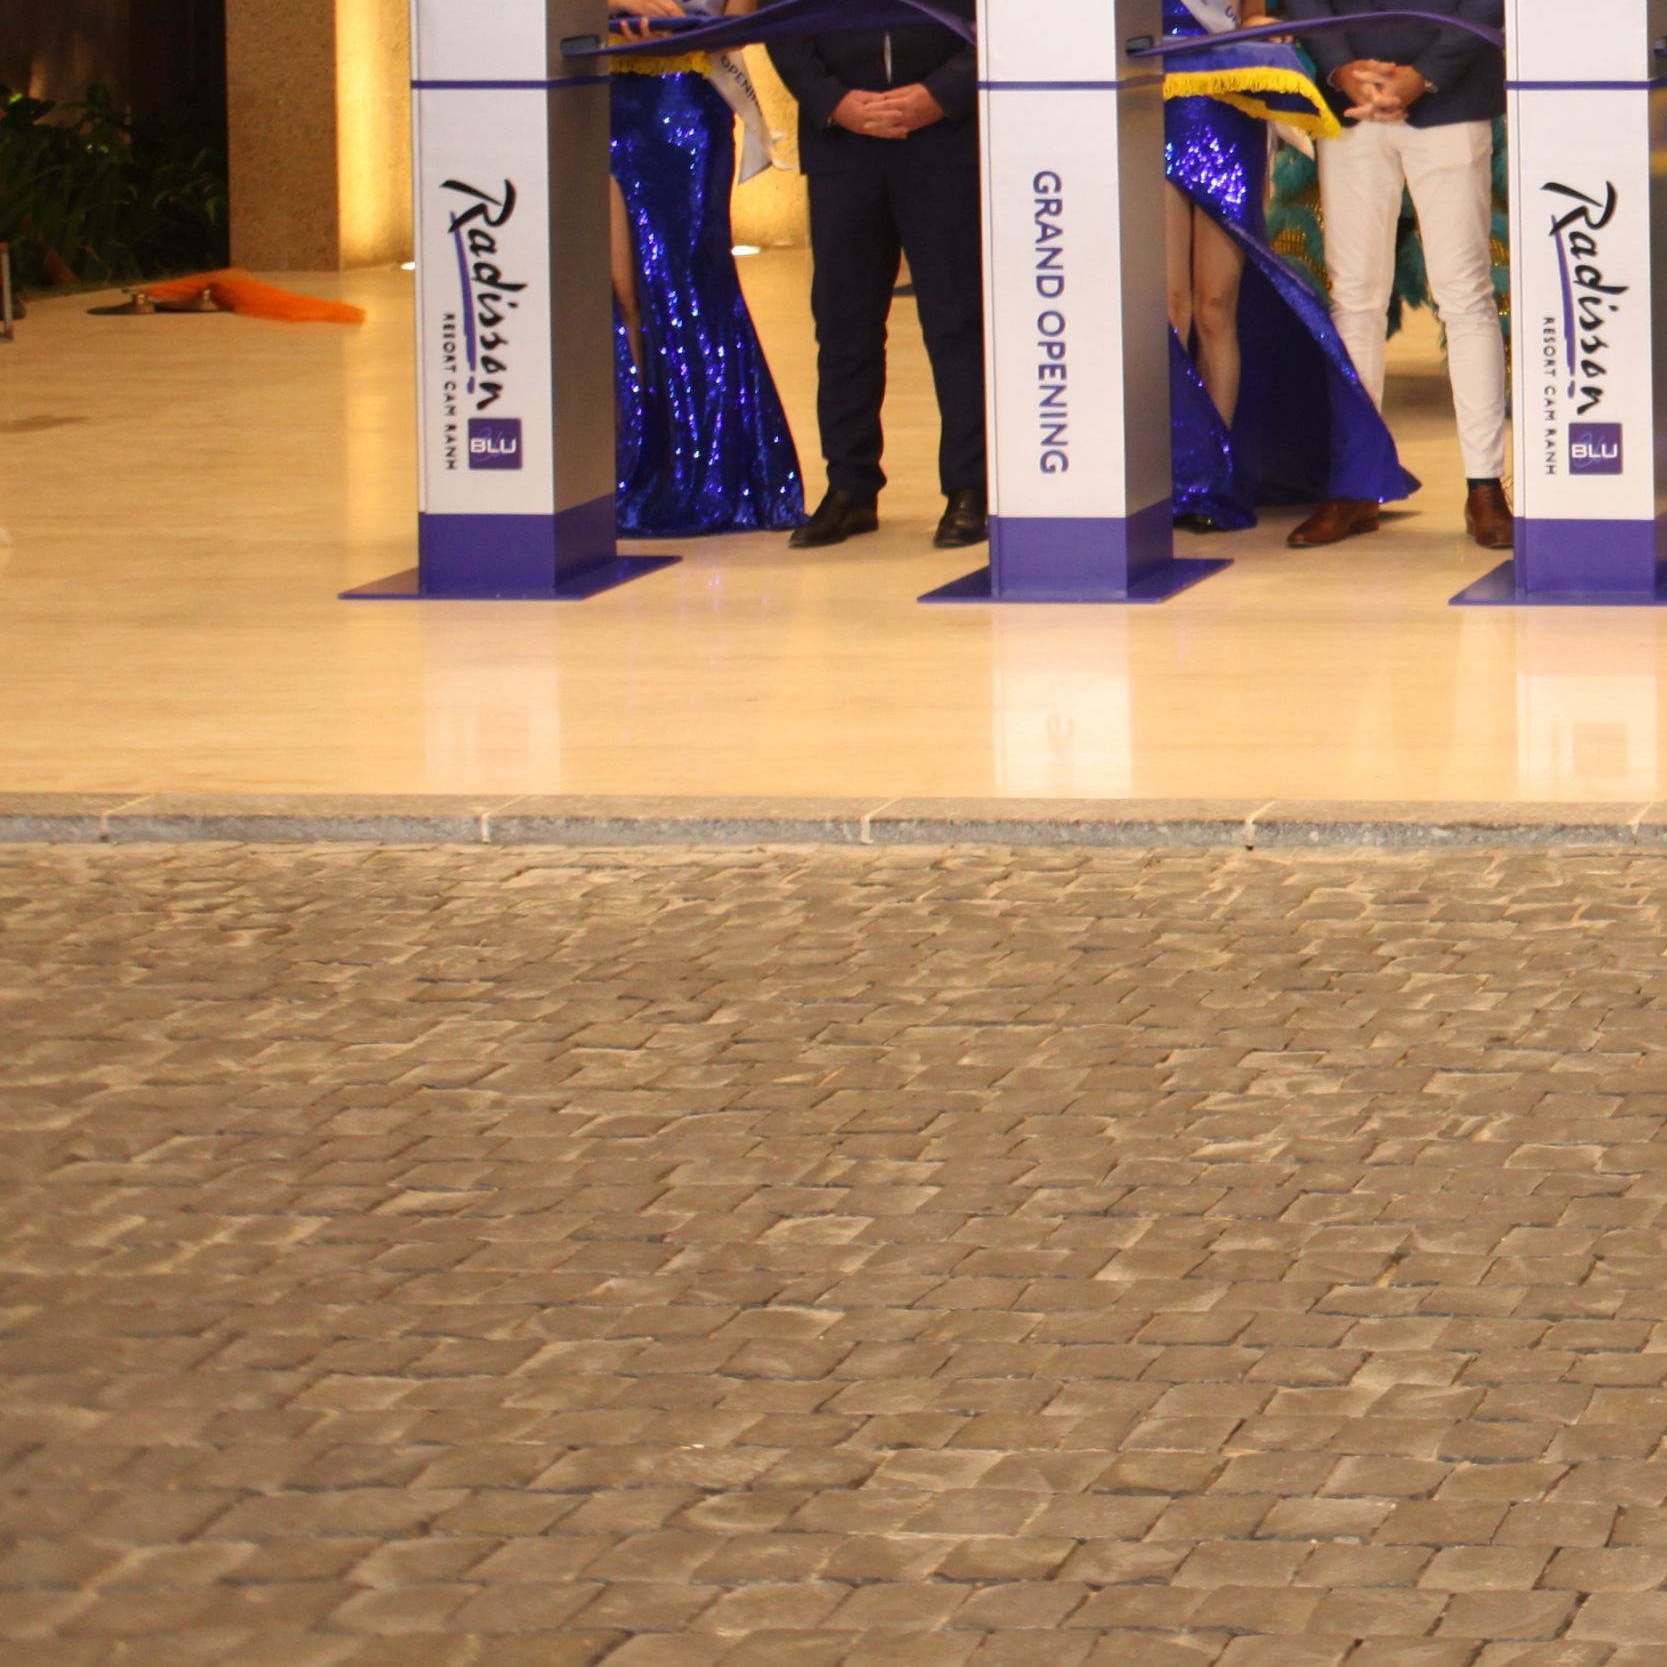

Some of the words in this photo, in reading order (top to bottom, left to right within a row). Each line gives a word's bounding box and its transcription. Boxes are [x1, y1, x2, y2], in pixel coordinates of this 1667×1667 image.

[1033, 170, 1065, 299] GRAND
[439, 178, 528, 411] Radisson
[1540, 180, 1630, 415] Radisson
[443, 313, 456, 372] RESORT
[1543, 316, 1555, 377] RESORT
[443, 381, 456, 417] CAM
[1036, 310, 1069, 475] OPENING
[1544, 386, 1556, 421] CAM
[444, 421, 457, 471] RANH
[470, 437, 516, 454] BLU
[1544, 428, 1557, 476] RANH
[1571, 443, 1618, 459] BLU
